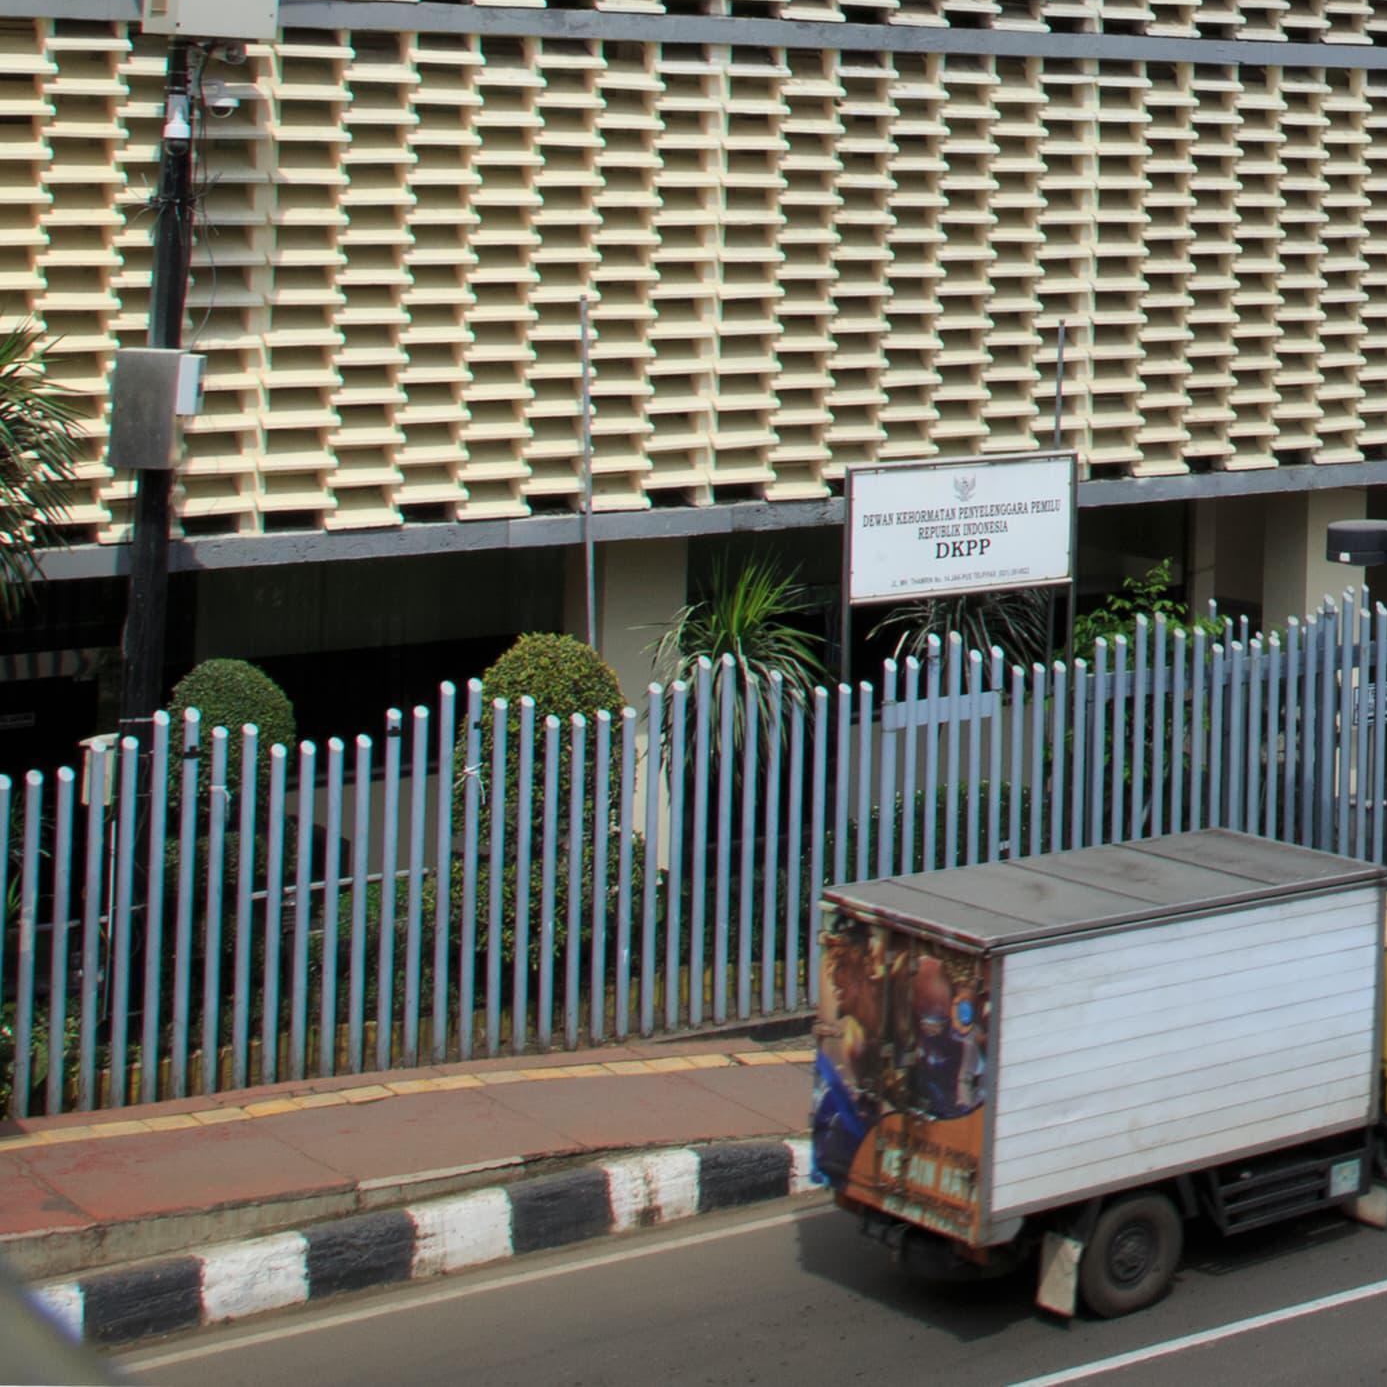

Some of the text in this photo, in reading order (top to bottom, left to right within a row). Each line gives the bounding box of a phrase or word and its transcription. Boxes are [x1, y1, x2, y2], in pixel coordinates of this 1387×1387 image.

[862, 499, 1061, 527] DEWAN KEHORMATAN PENYELENGGARA PEMILU
[918, 521, 1008, 540] REPUBLIK INDONESIA
[935, 538, 991, 559] DKPP
